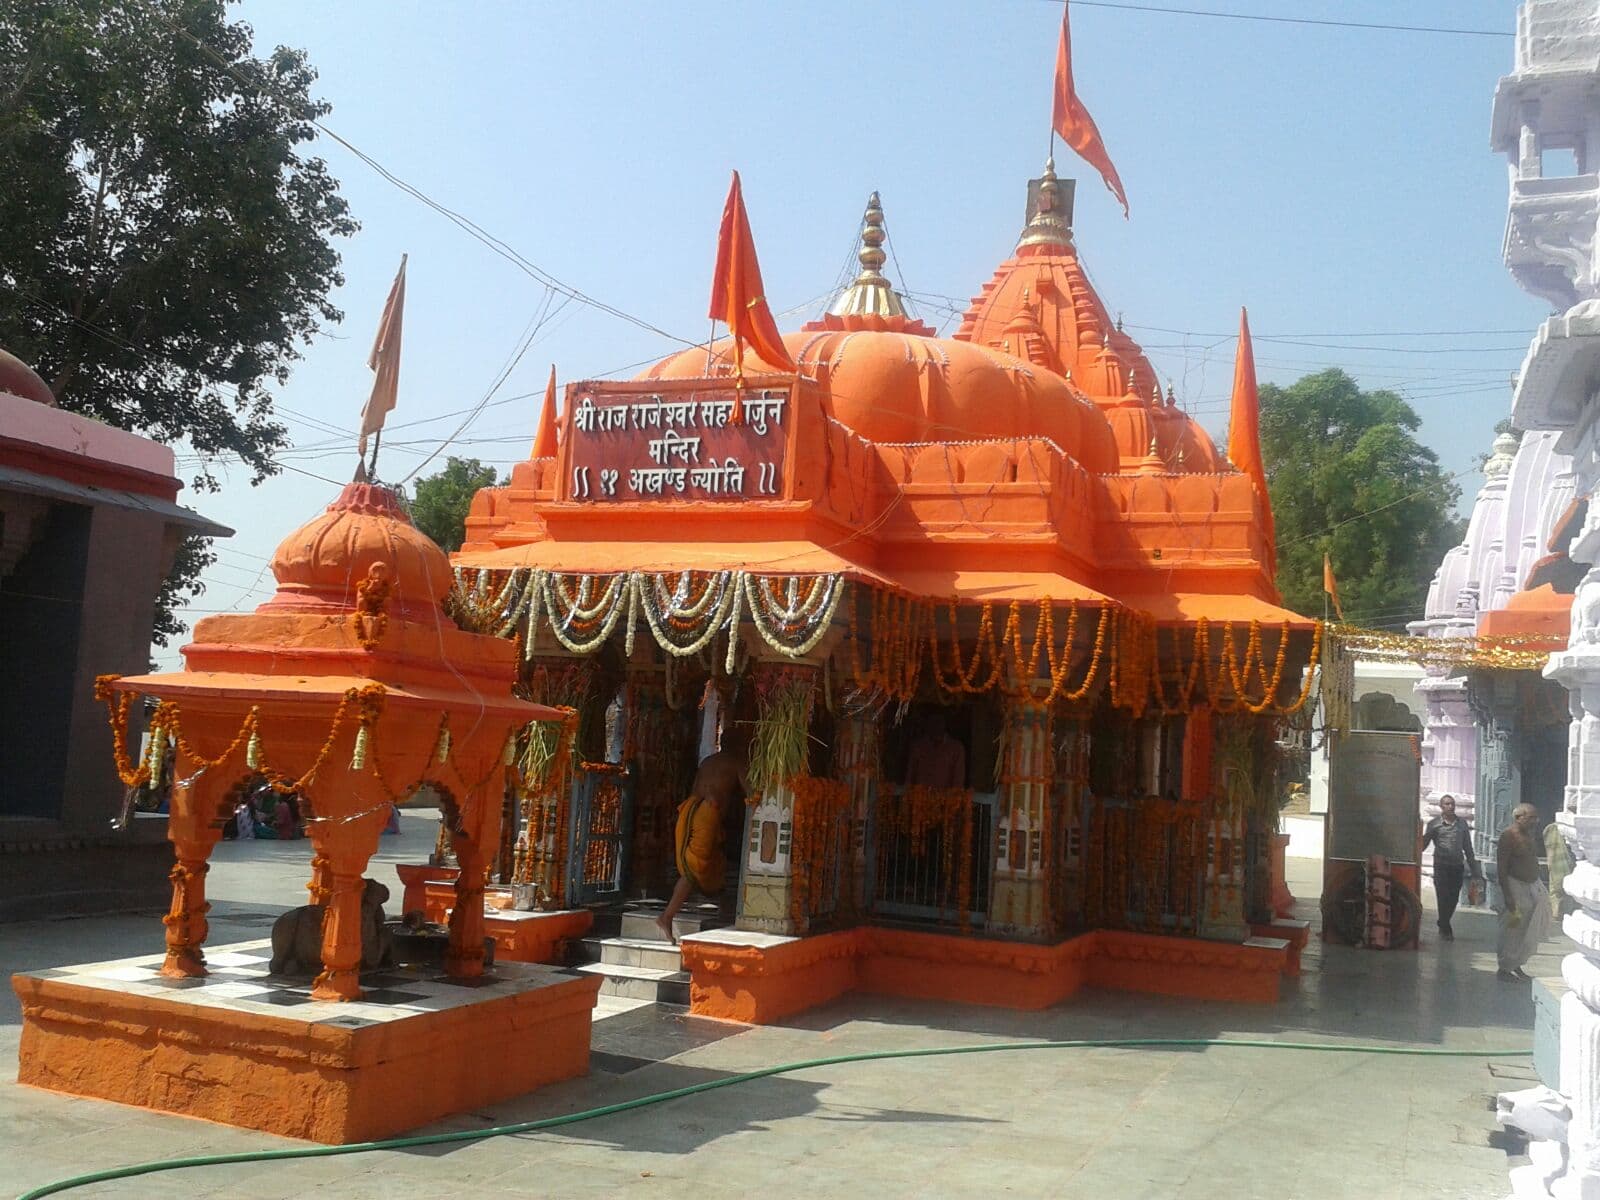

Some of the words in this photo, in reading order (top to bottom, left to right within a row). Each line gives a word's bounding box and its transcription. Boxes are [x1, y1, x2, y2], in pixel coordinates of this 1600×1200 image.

[574, 397, 595, 431] श्री
[598, 405, 628, 431] राज
[632, 395, 698, 428] राजेश्वर
[649, 429, 700, 464] मन्दिर
[628, 468, 687, 494] अखण्ड
[690, 457, 744, 493] ज्योति
